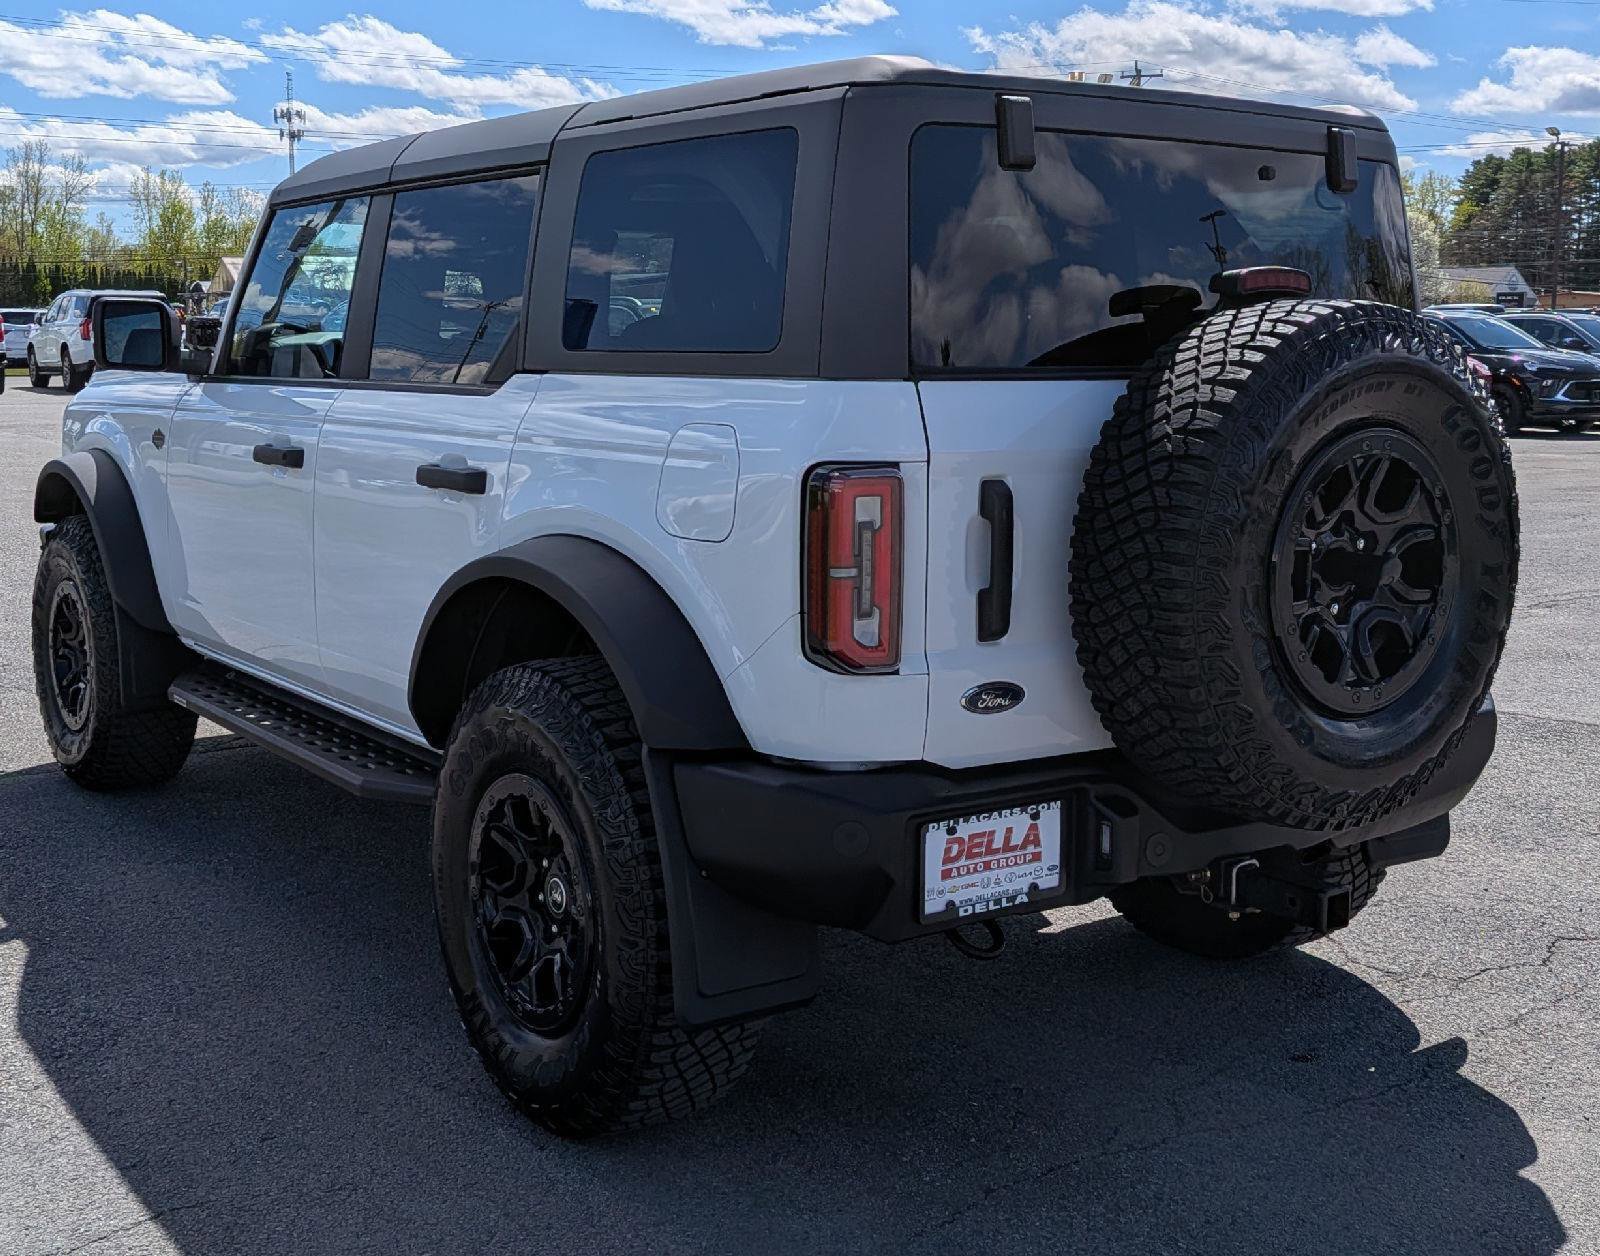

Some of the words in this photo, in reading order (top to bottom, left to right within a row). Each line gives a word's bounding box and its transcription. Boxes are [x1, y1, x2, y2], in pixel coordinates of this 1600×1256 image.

[977, 690, 1013, 708] Ford
[928, 801, 1060, 833] DELLACARS.COM
[942, 822, 1042, 866] DELLA
[951, 862, 984, 877] AUTO
[990, 853, 1033, 870] GROUP
[959, 894, 1029, 917] DELLA
